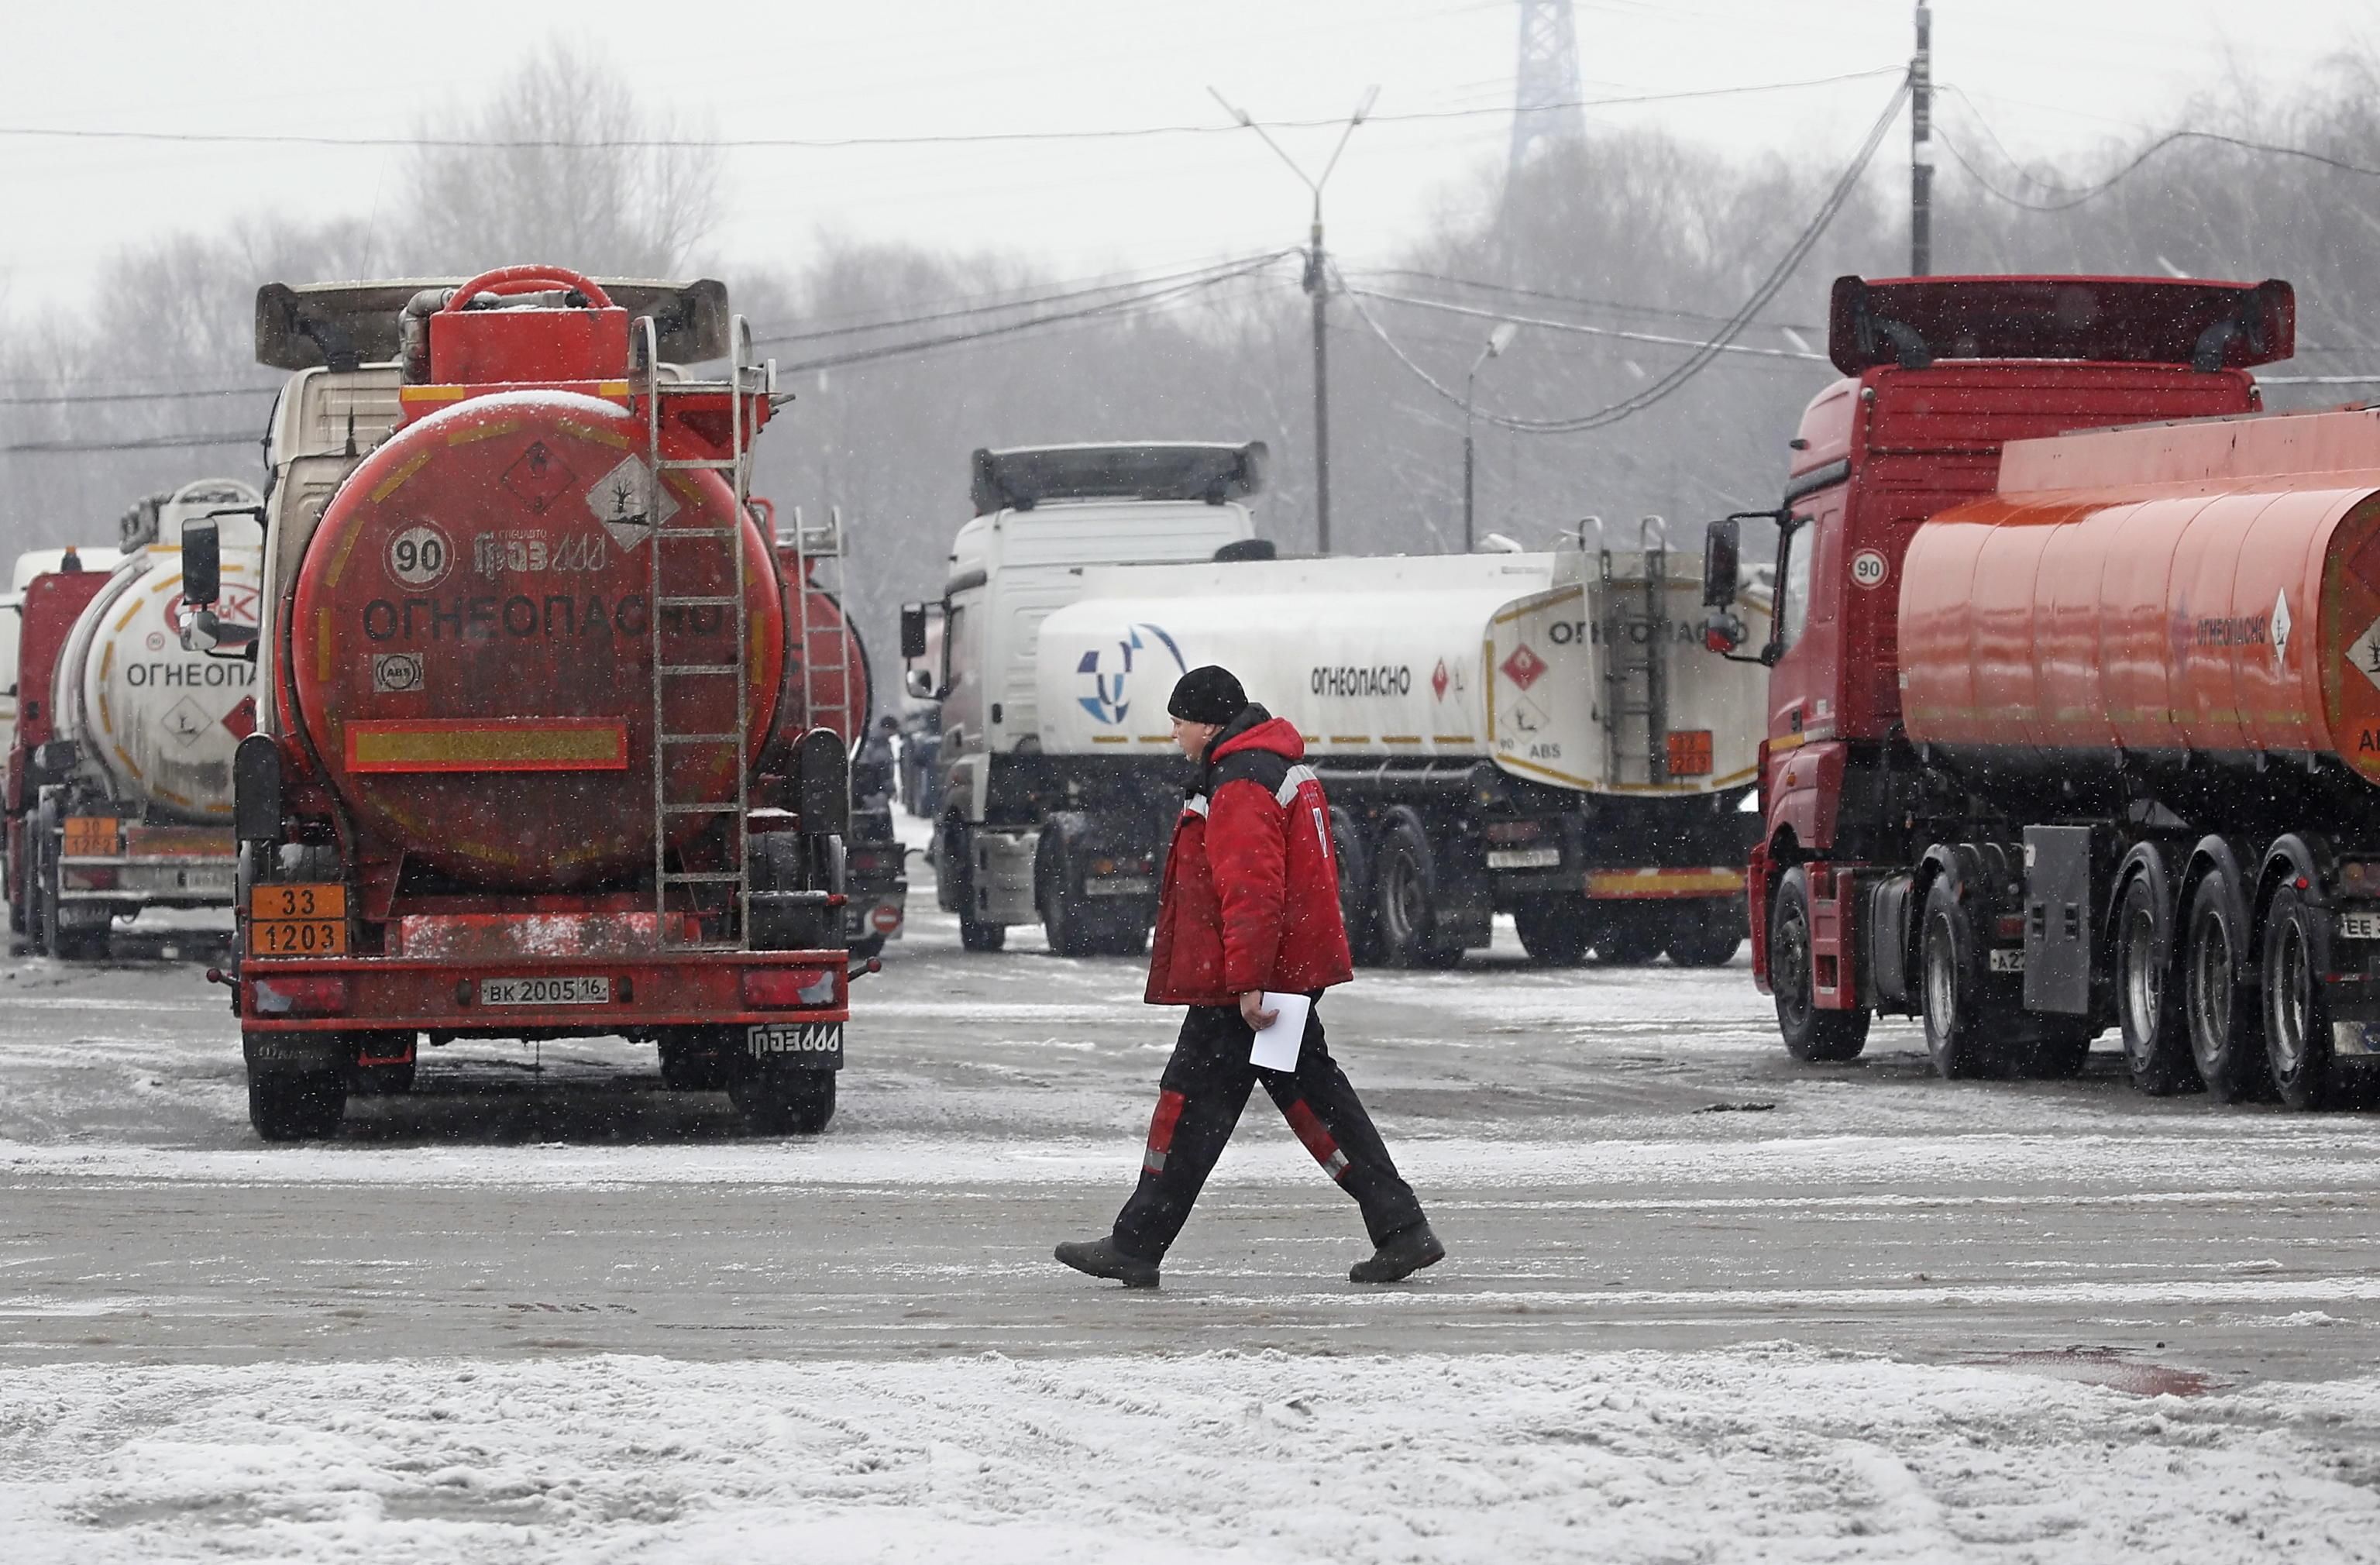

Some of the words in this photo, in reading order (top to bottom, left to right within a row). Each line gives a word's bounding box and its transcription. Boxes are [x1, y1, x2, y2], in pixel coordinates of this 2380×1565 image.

[397, 540, 441, 572] 90
[1859, 561, 1880, 576] 90
[1312, 666, 1411, 697] ОГНЕОПАСНО
[1530, 743, 1561, 758] ABS
[282, 889, 315, 915] 33
[266, 924, 334, 951] 1203
[521, 981, 575, 1001] 2005
[582, 979, 600, 994] 16
